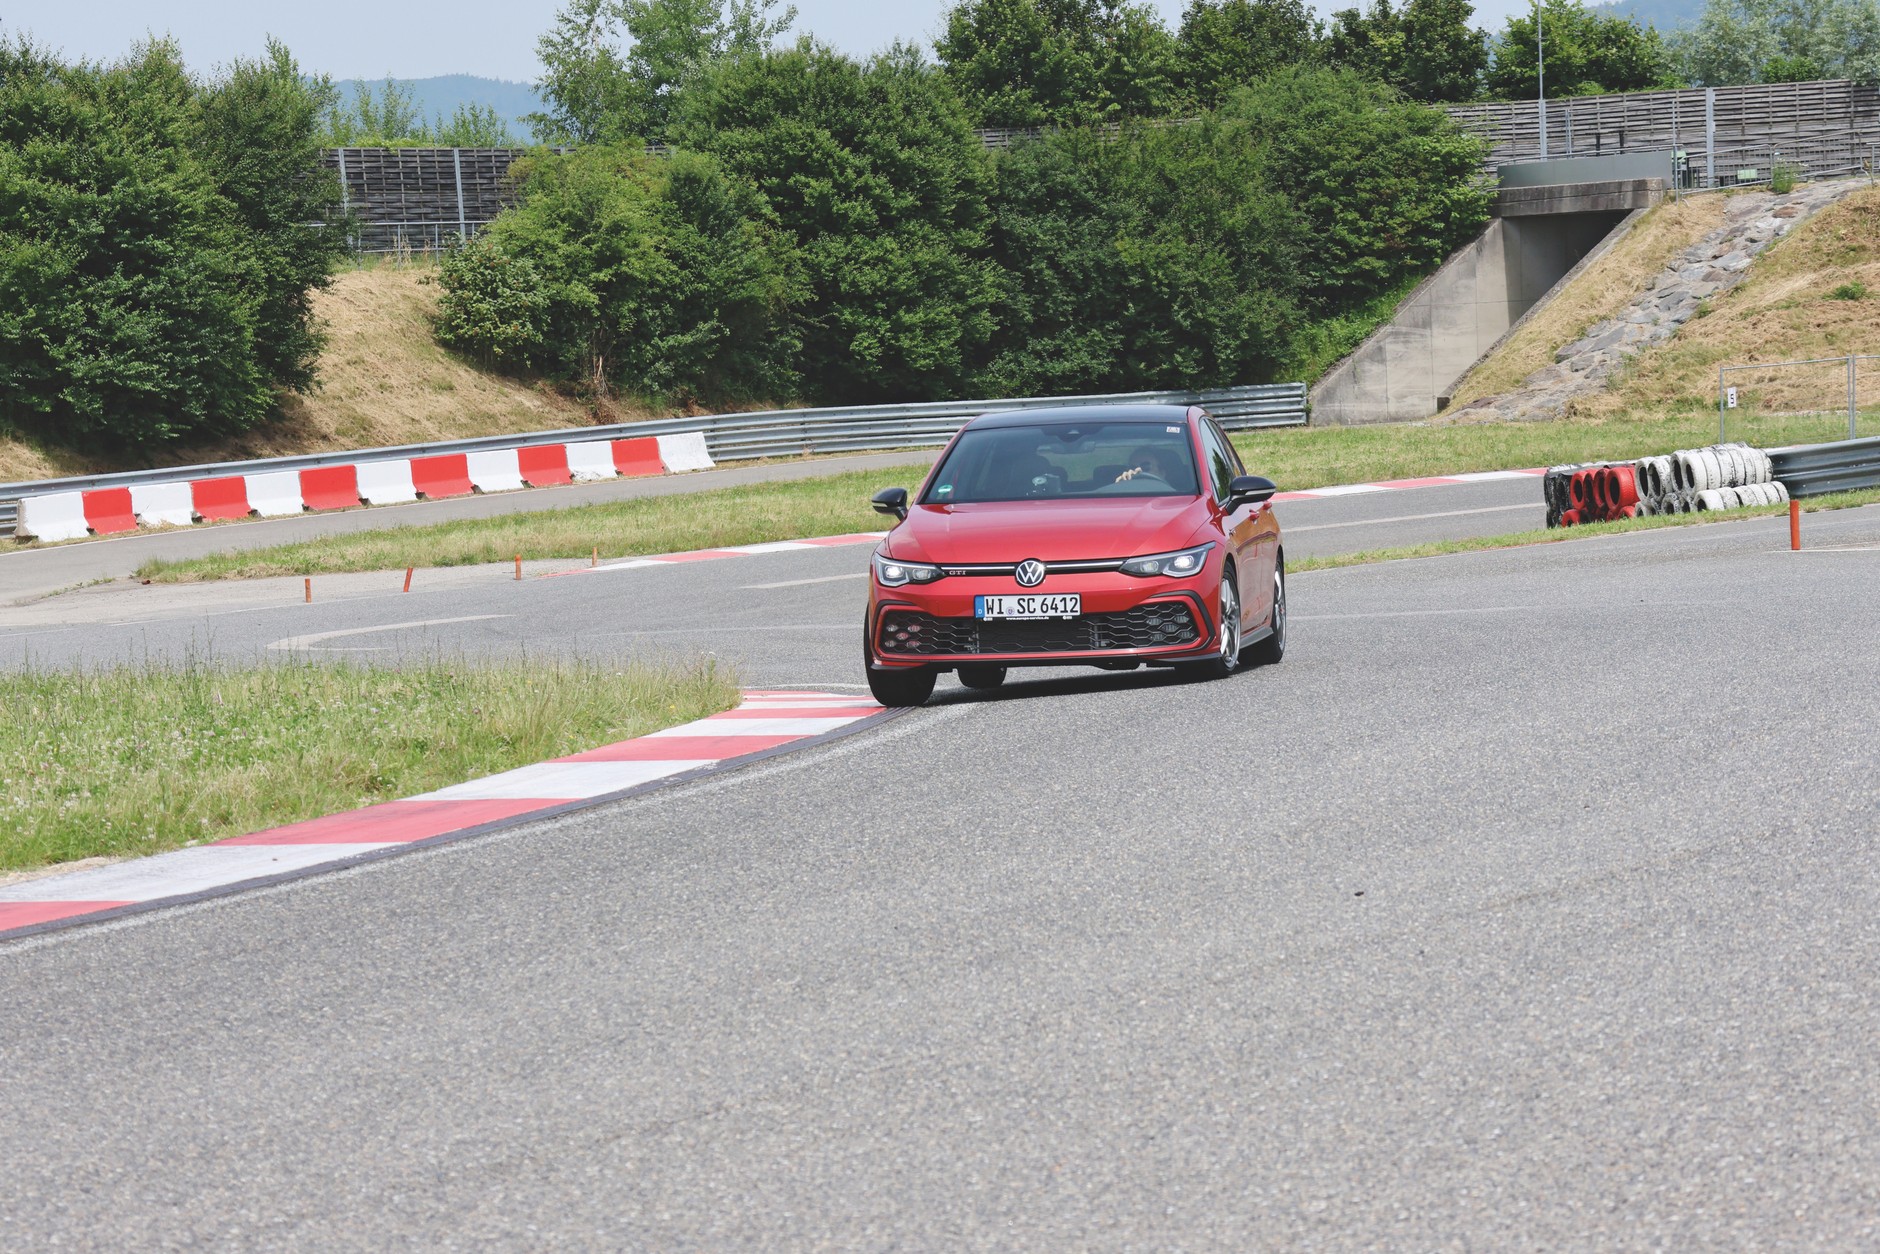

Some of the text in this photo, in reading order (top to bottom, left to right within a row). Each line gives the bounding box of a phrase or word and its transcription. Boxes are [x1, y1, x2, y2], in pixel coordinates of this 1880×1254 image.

[985, 597, 1079, 615] WI SC 6412
